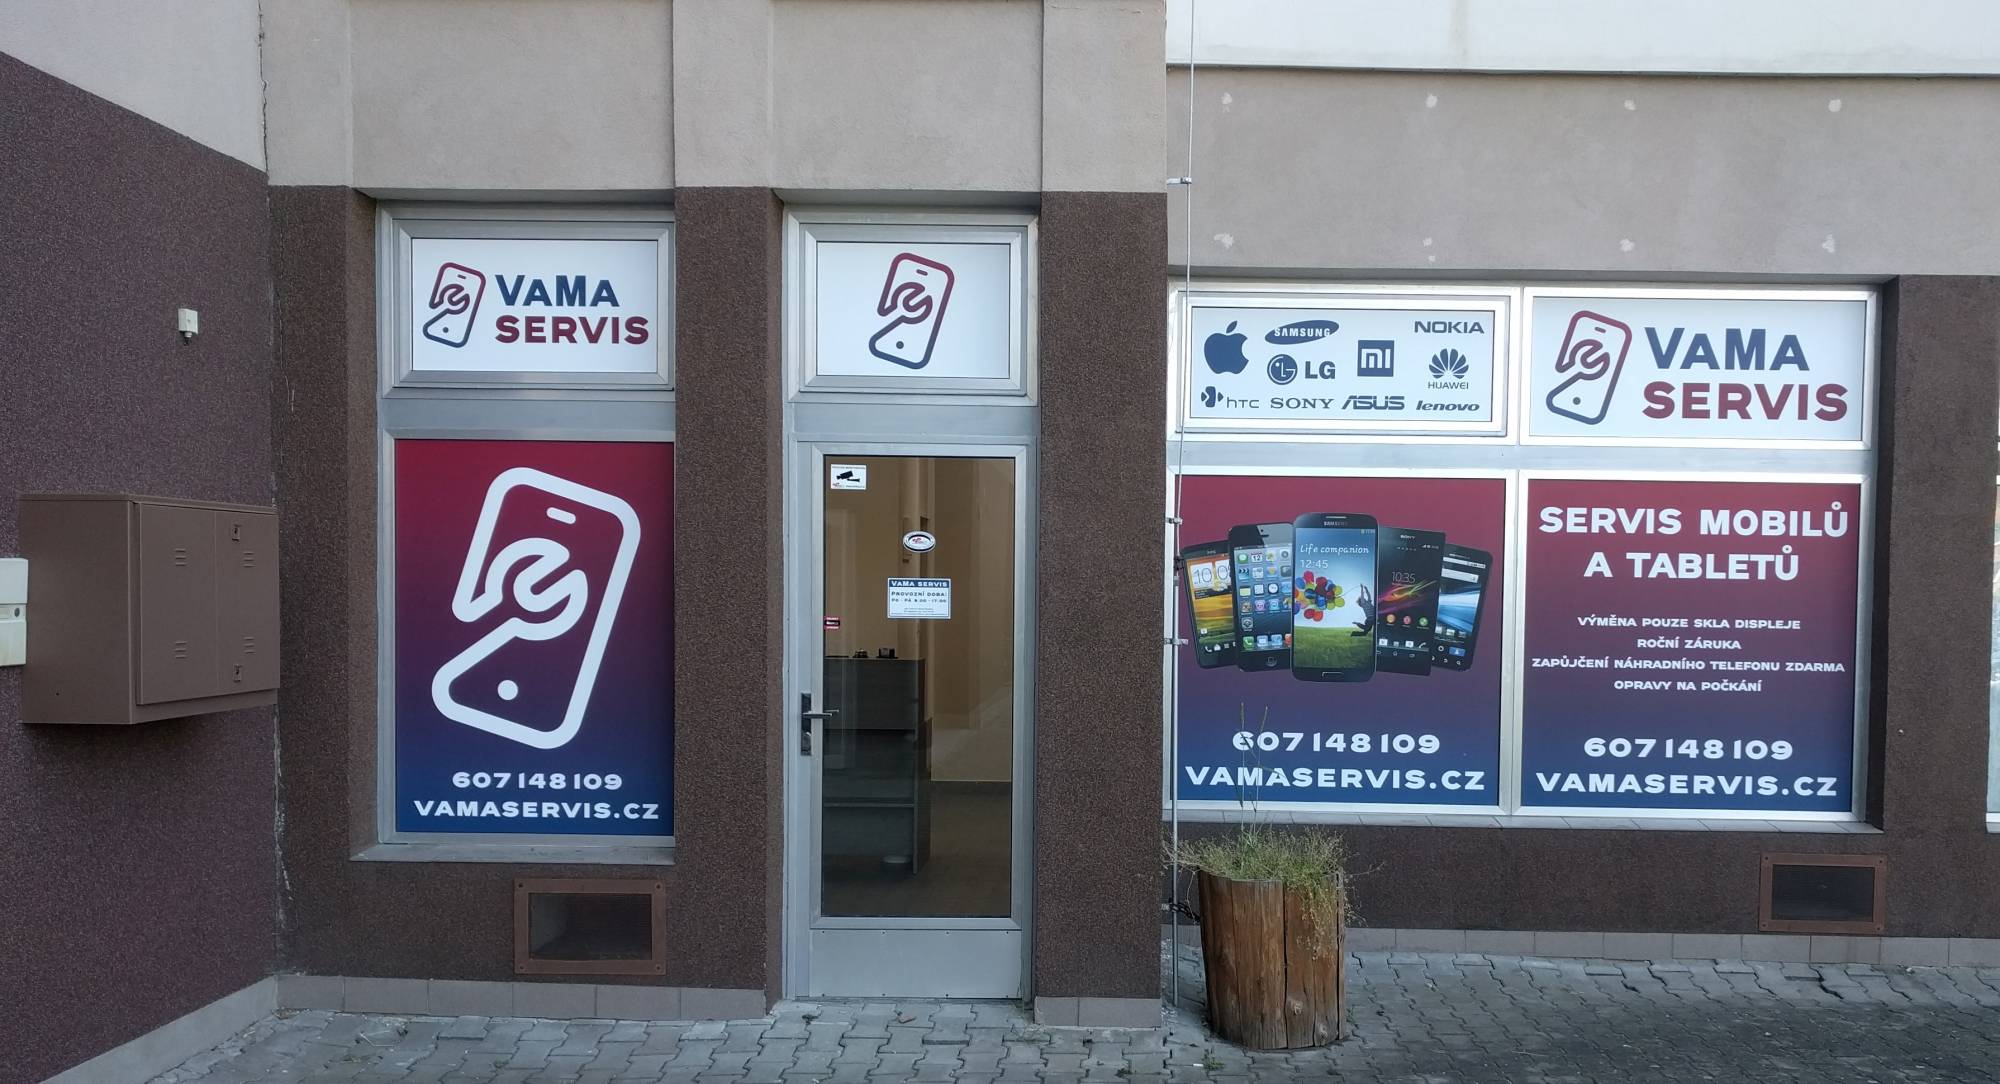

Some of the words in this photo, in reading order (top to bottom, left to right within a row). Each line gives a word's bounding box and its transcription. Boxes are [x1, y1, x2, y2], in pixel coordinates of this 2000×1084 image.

[495, 274, 620, 307] VAMA
[495, 315, 649, 345] SERVIS
[1274, 327, 1331, 338] SAMSUNG
[1414, 320, 1484, 334] NOKIA
[1644, 327, 1810, 371] VAMA
[1305, 360, 1336, 380] LG
[1428, 381, 1469, 390] HUAWEI
[1270, 397, 1334, 410] SONY
[1341, 395, 1406, 411] ASUS
[1416, 400, 1480, 412] lenovo
[1642, 380, 1849, 422] SERVIS
[1539, 506, 1682, 535] SERVIS
[1699, 501, 1848, 538] MOBILŮ
[1300, 543, 1318, 555] Life
[1320, 545, 1370, 556] companion
[1299, 559, 1329, 569] 12:45
[1583, 551, 1614, 578] A
[1626, 544, 1799, 581] TABLETŮ
[1577, 614, 1638, 627] VÝMĚNA
[1642, 617, 1689, 628] POUZE
[1694, 618, 1730, 629] SKLA
[1735, 618, 1801, 630] DISPLEJE
[1637, 636, 1679, 649] ROČNÍ
[1684, 637, 1742, 650] ZÁRUKA
[1532, 655, 1609, 669] ZAPŮJČENÍ
[1614, 657, 1706, 671] NÁHRADNÍHO
[1710, 660, 1780, 672] TELEFONU
[1785, 661, 1845, 673] ZDARMA
[1614, 680, 1672, 692] OPRAVY
[1676, 680, 1697, 692] NA
[1701, 678, 1763, 692] POČKÁNÍ
[1184, 765, 1486, 791] VAMASERVIS.CZ
[1535, 772, 1838, 797] VAMASERVIS.CZ
[414, 800, 659, 820] VAMASERVIS.CZ
